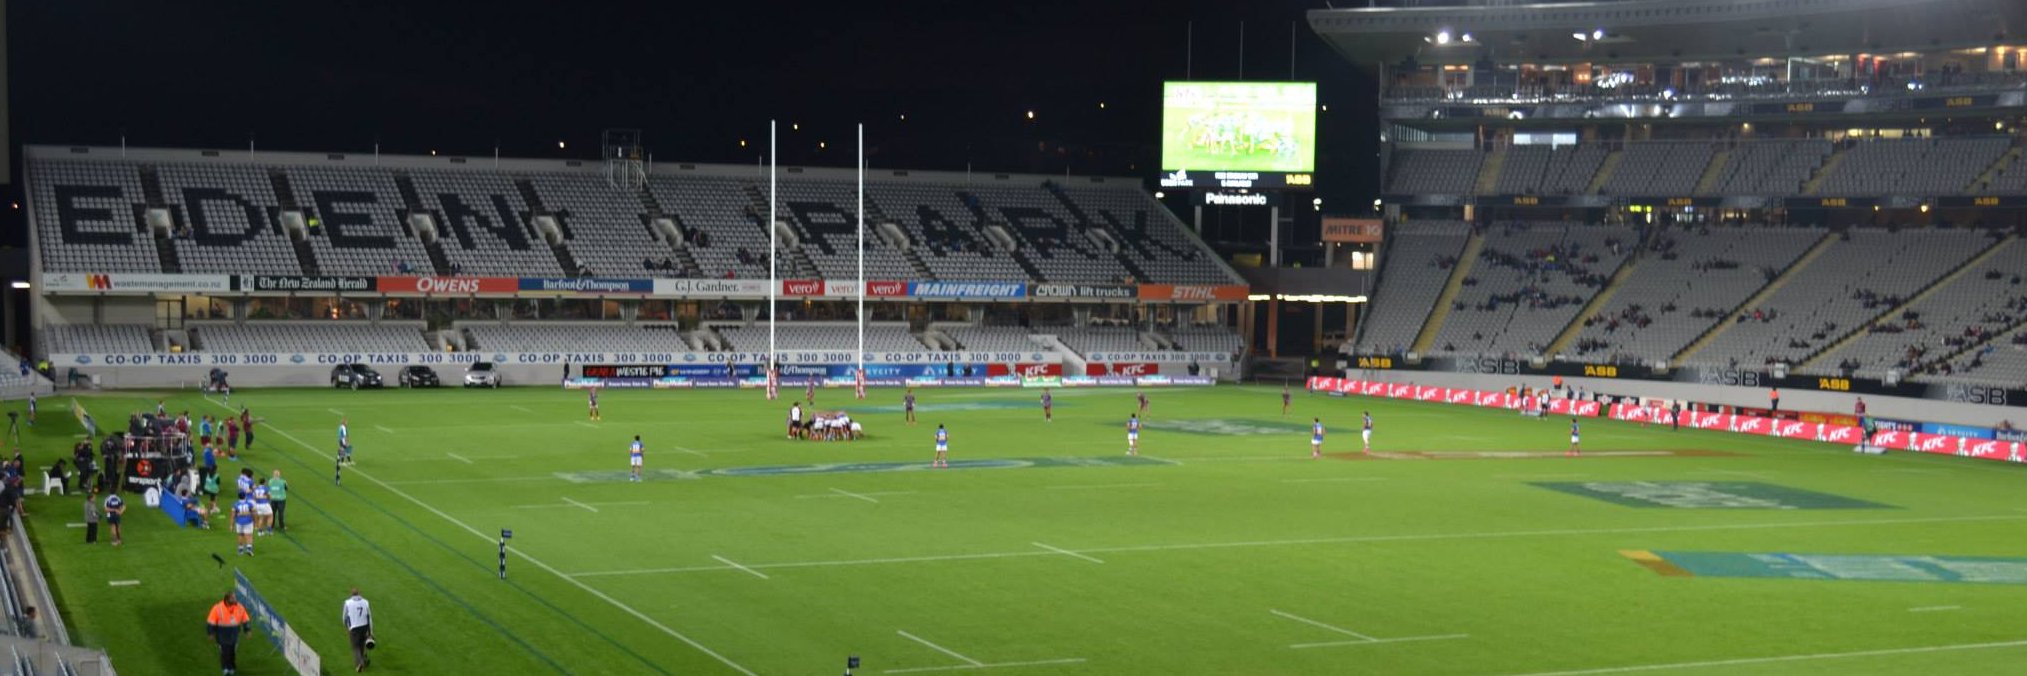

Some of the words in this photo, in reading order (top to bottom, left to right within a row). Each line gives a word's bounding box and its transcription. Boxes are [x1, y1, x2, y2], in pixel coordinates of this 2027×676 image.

[1205, 192, 1267, 205] Panasonic
[54, 184, 533, 251] EDEN
[787, 198, 1202, 262] PARK
[1326, 224, 1361, 235] MITRE
[1366, 225, 1381, 235] 10
[114, 279, 221, 290] wastemanagement.co.nz
[260, 277, 277, 289] The
[280, 277, 299, 289] New
[301, 277, 336, 289] Zealand
[338, 277, 367, 289] Herald
[416, 277, 479, 293] OWENS
[675, 281, 693, 293] G.J.
[788, 284, 813, 294] vero
[831, 285, 855, 294] vero
[872, 285, 897, 296] vero
[914, 284, 1020, 296] MAINFREIGHT
[1080, 285, 1095, 296] lift
[1097, 286, 1130, 297] trucks
[1172, 286, 1217, 299] STIHL
[105, 355, 151, 365] CO-OP
[159, 354, 202, 365] TAXIS
[211, 355, 237, 365] 300
[243, 355, 278, 364] 3000
[318, 354, 362, 364] CO-OP
[369, 354, 409, 364] TAXIS
[418, 354, 443, 364] 300
[449, 354, 481, 364] 3000
[518, 353, 560, 363] CO-OP
[566, 353, 605, 363] TAXIS
[614, 353, 636, 363] 300
[642, 353, 672, 363] 3000
[752, 353, 788, 362] TAIS
[797, 353, 818, 362] 300
[823, 353, 852, 362] 3000
[885, 353, 922, 362] CO-OP
[929, 353, 961, 362] TAXIS
[971, 353, 989, 362] 300
[995, 353, 1021, 362] 3000
[1108, 353, 1136, 361] CO-OP
[1140, 353, 1166, 361] TAXIS
[1358, 357, 1392, 369] ASB
[1025, 364, 1048, 377] KFC
[1122, 364, 1145, 376] KFC
[1459, 358, 1521, 374] ASB
[1585, 364, 1618, 377] ASB
[1701, 366, 1760, 388] ASB
[1819, 378, 1849, 390] ASB
[1483, 393, 1498, 405] KFC
[1949, 385, 2006, 406] ASB
[1578, 402, 1595, 415] KFC
[1701, 414, 1720, 428] KFC
[1741, 418, 1760, 432] KFC
[1783, 422, 1804, 436] KFC
[1829, 427, 1851, 441] KFC
[1875, 432, 1898, 446] KFC
[1922, 437, 1946, 451] KFC
[1972, 441, 1996, 456] KFC
[357, 607, 363, 617] 7
